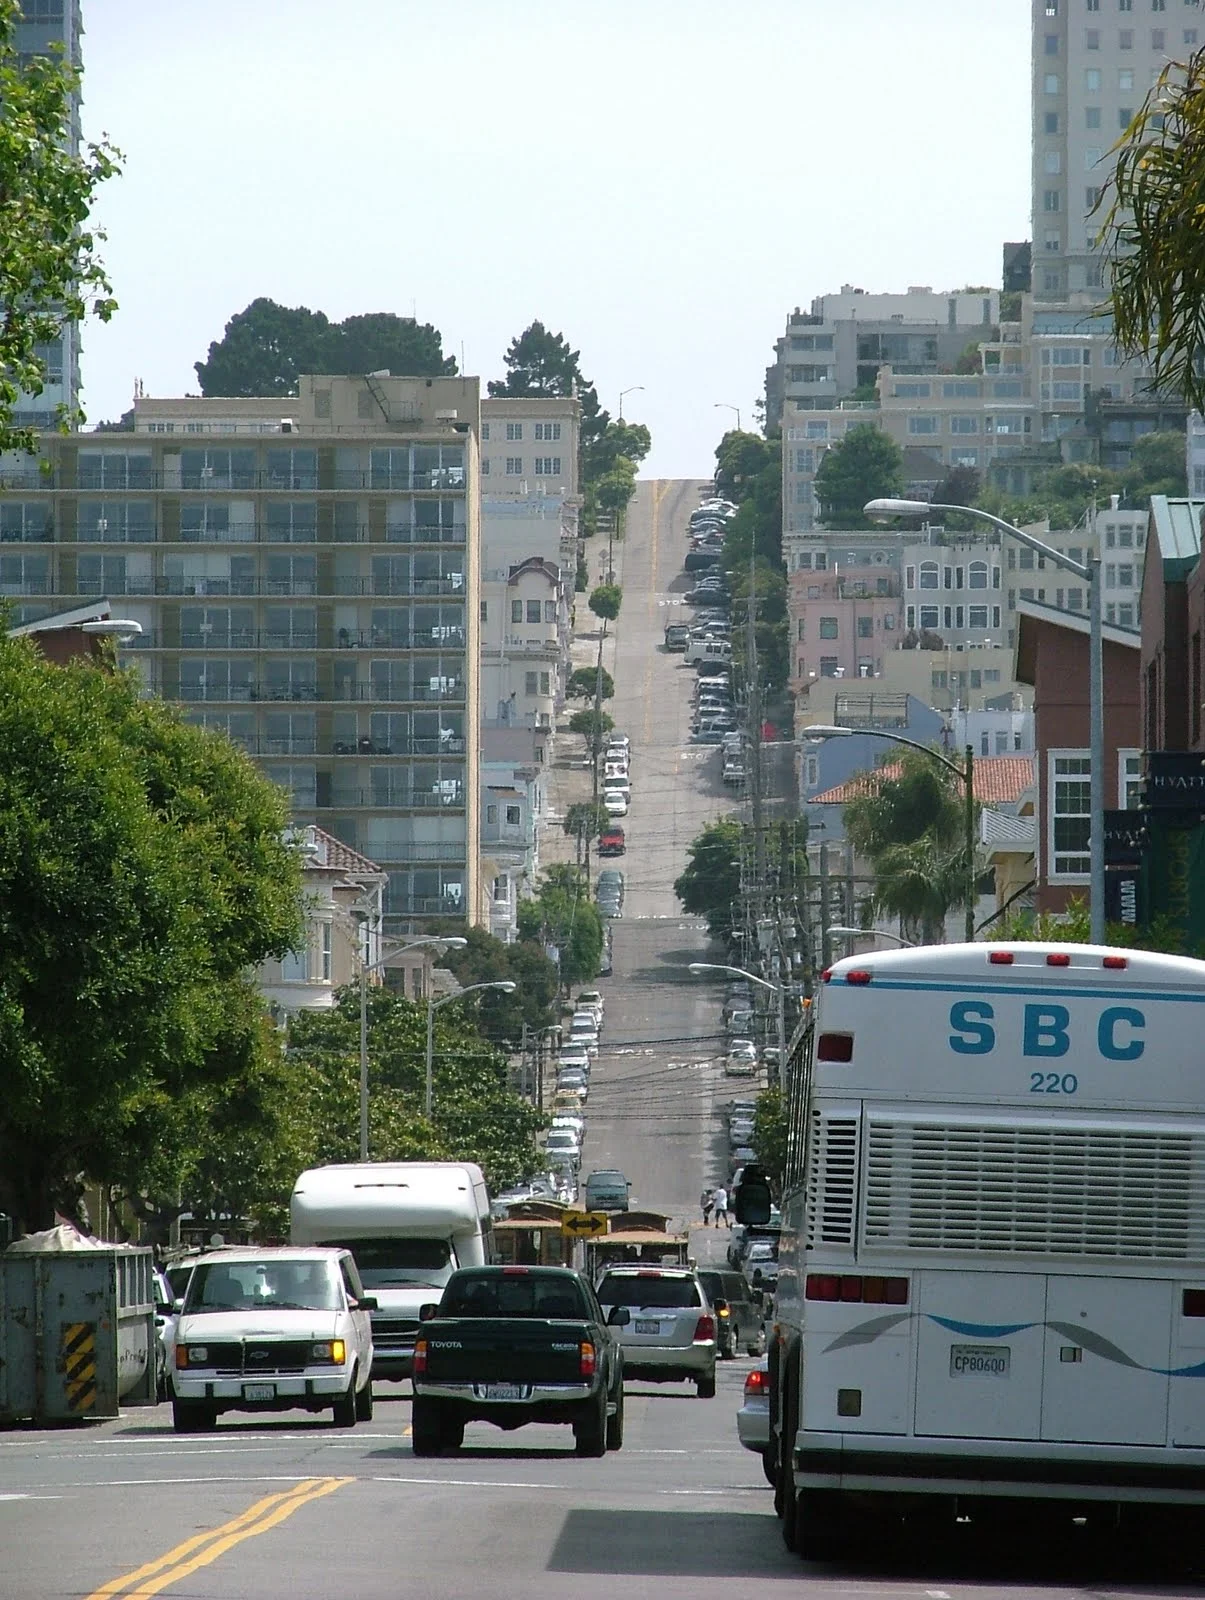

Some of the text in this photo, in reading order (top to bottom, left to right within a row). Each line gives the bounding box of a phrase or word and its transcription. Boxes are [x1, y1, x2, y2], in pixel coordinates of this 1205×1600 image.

[1155, 776, 1205, 789] HYATT
[1029, 1072, 1078, 1094] 220
[430, 1340, 463, 1349] TOYOTA
